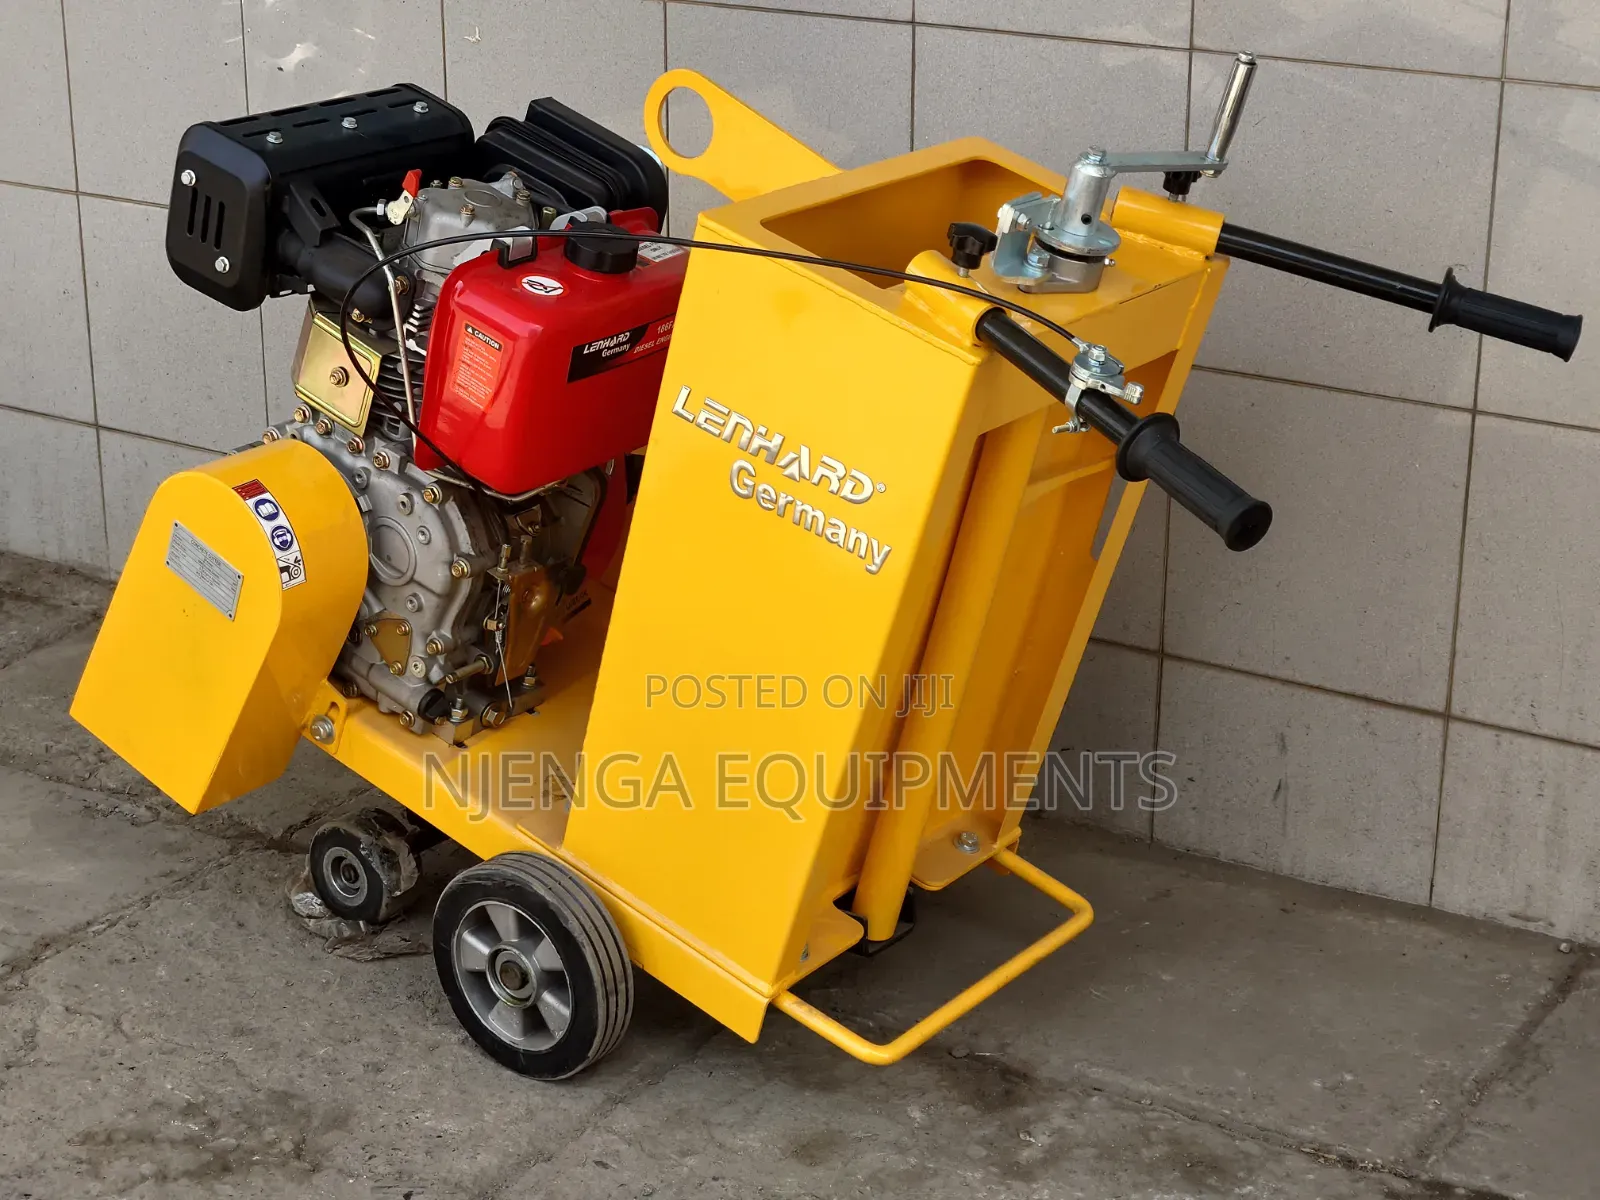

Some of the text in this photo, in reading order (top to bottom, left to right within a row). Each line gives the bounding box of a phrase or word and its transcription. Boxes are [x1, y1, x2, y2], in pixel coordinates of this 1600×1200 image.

[657, 320, 674, 334] 186F
[474, 330, 500, 350] CAUTION
[583, 331, 631, 355] LENHARD
[633, 340, 655, 354] DIESEL
[602, 342, 631, 358] Germany
[729, 459, 892, 575] Germany
